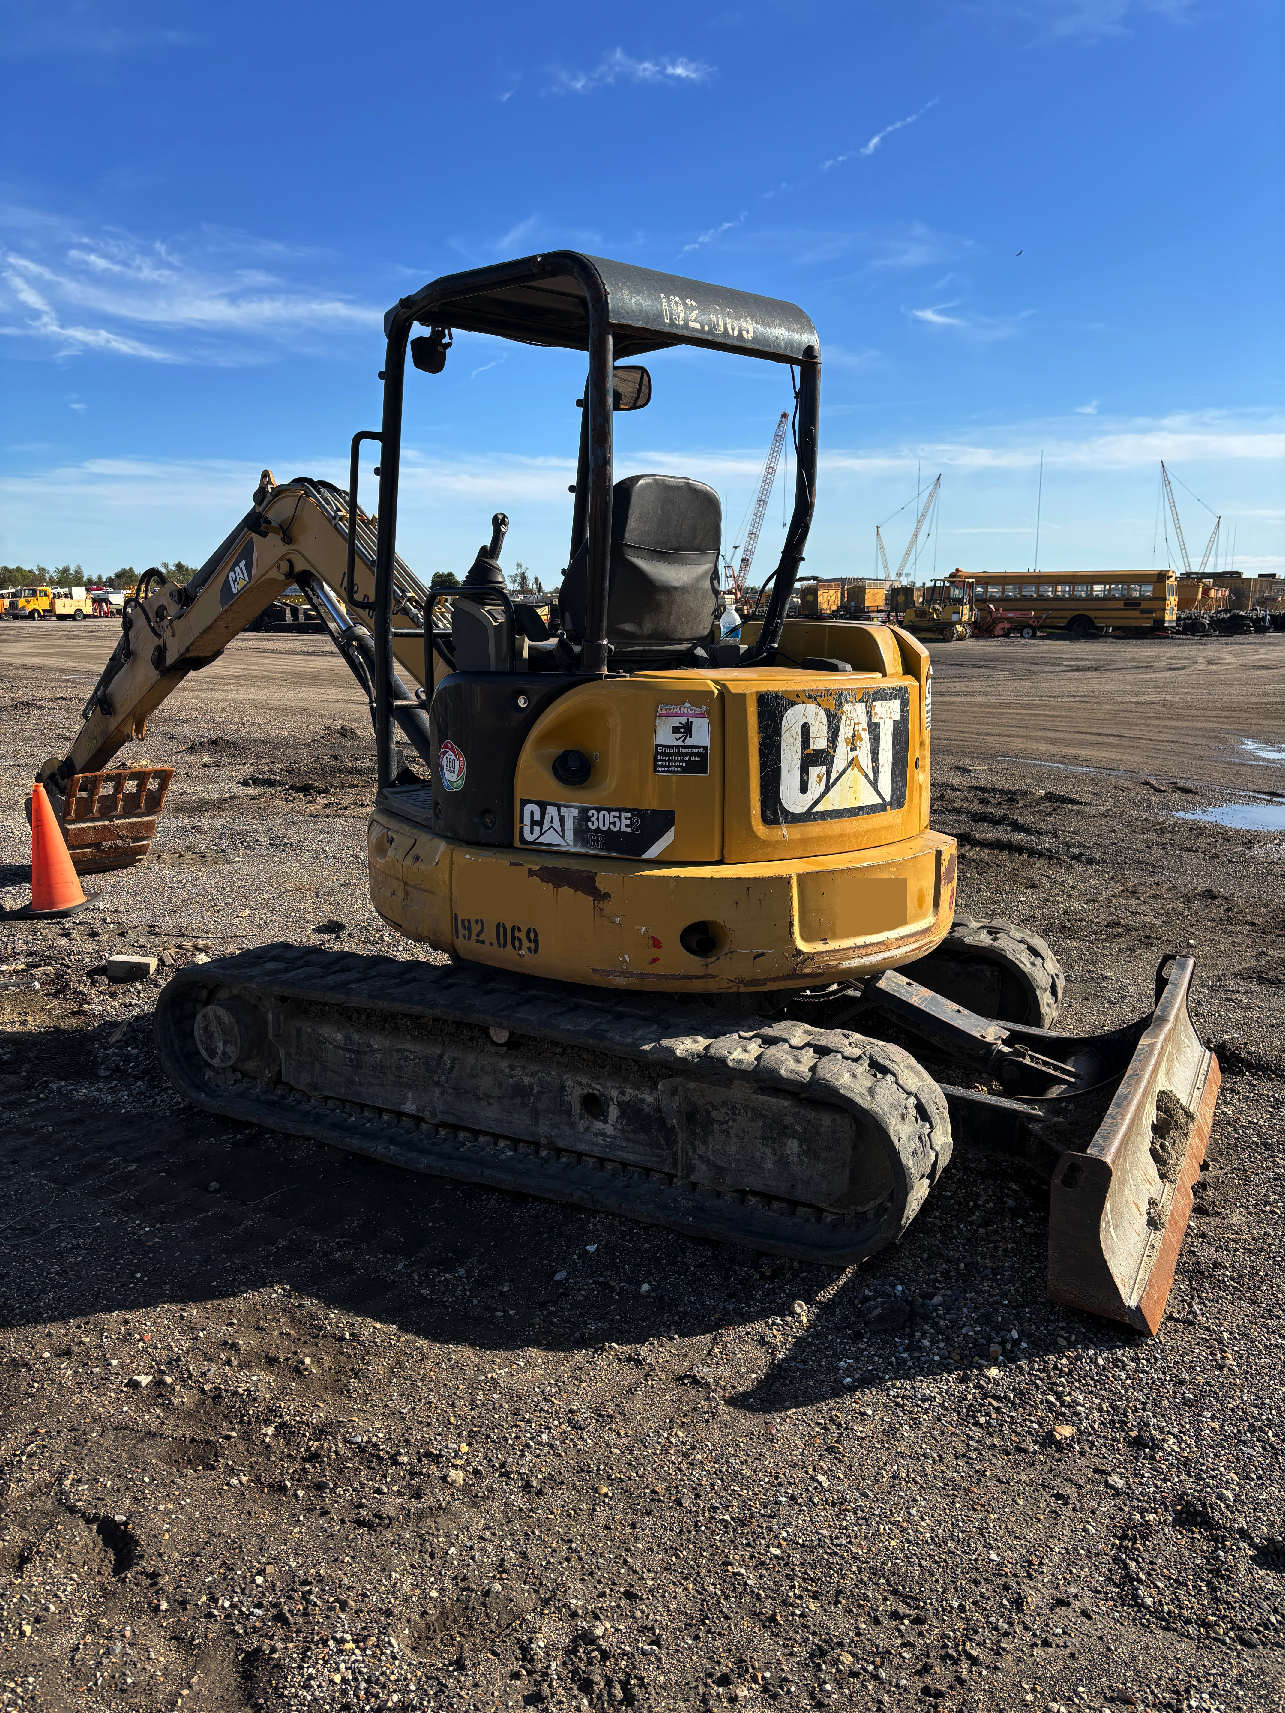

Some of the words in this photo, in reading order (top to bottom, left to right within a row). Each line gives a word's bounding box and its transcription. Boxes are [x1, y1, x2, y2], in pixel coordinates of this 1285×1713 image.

[228, 559, 250, 594] CAT
[779, 698, 901, 814] CAT
[523, 803, 579, 846] CAT
[453, 912, 540, 955] 192.069
